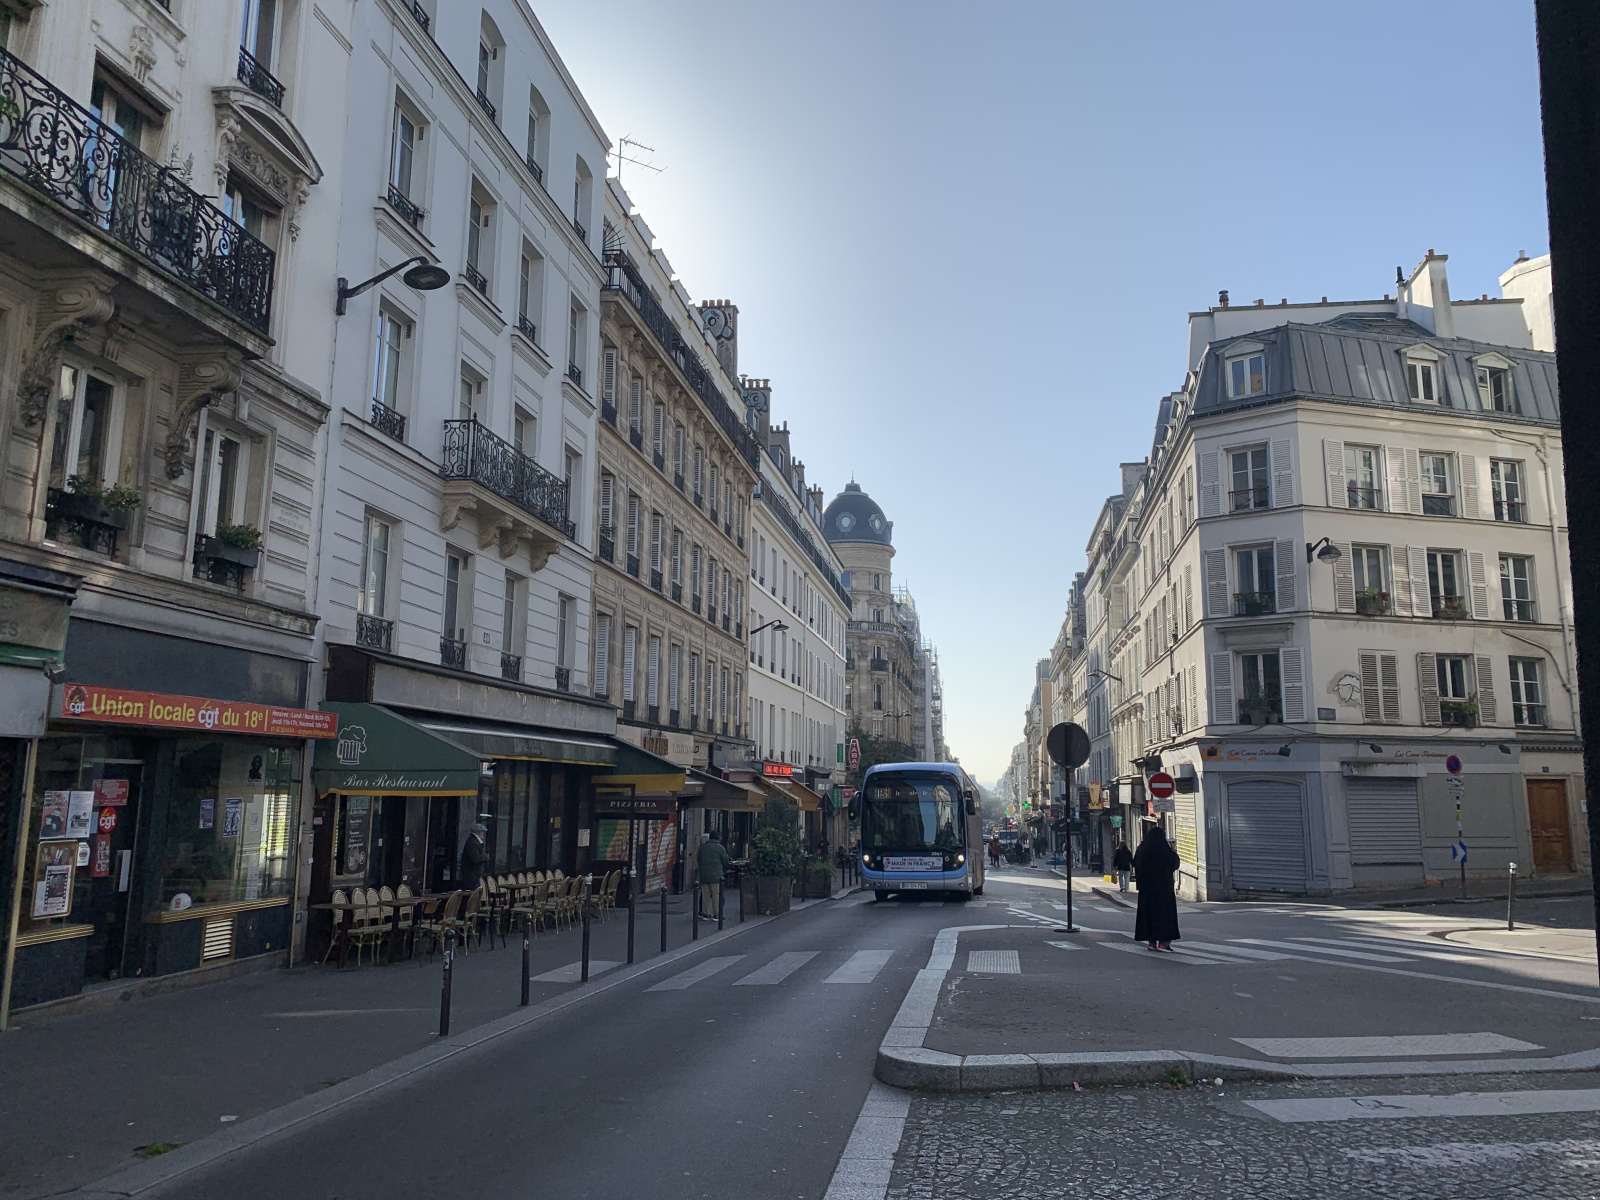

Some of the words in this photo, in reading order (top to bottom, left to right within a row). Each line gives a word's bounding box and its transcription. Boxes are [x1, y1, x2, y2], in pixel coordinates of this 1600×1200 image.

[70, 701, 85, 714] cgt
[92, 693, 144, 718] Union
[149, 699, 196, 723] locale
[198, 707, 219, 728] cgt
[222, 707, 239, 727] du
[343, 774, 368, 787] Bar
[372, 773, 448, 788] Restaurant
[99, 814, 116, 829] cgt
